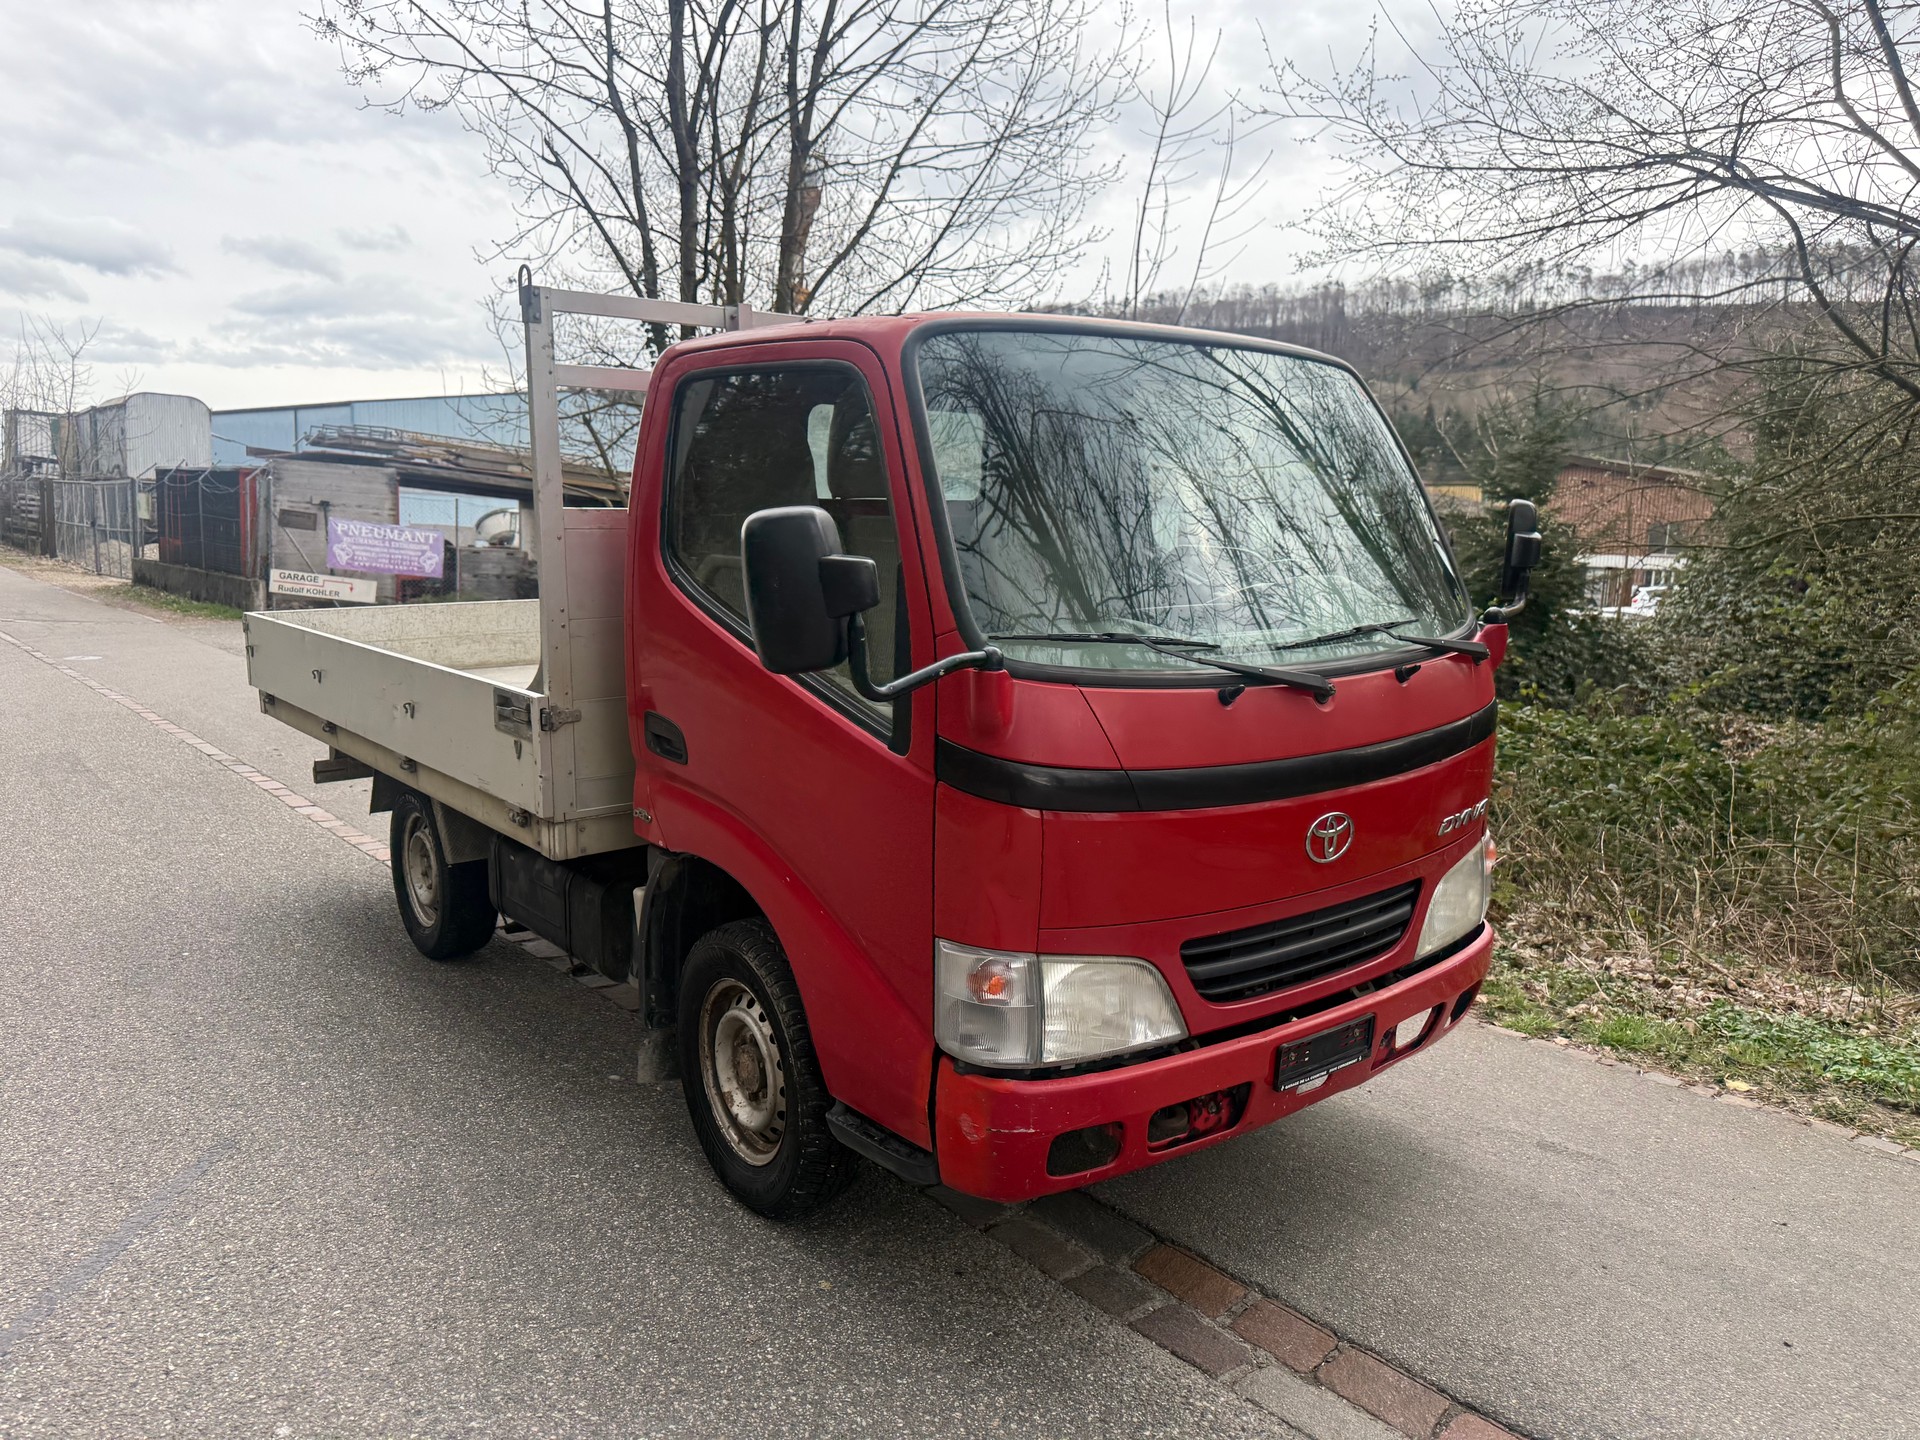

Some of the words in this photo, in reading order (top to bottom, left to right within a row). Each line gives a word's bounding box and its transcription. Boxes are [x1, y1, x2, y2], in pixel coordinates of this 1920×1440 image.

[337, 523, 437, 544] PNEUMANT
[279, 571, 320, 583] GARAGE
[278, 585, 304, 594] Rudolf
[306, 588, 340, 597] KOHLER
